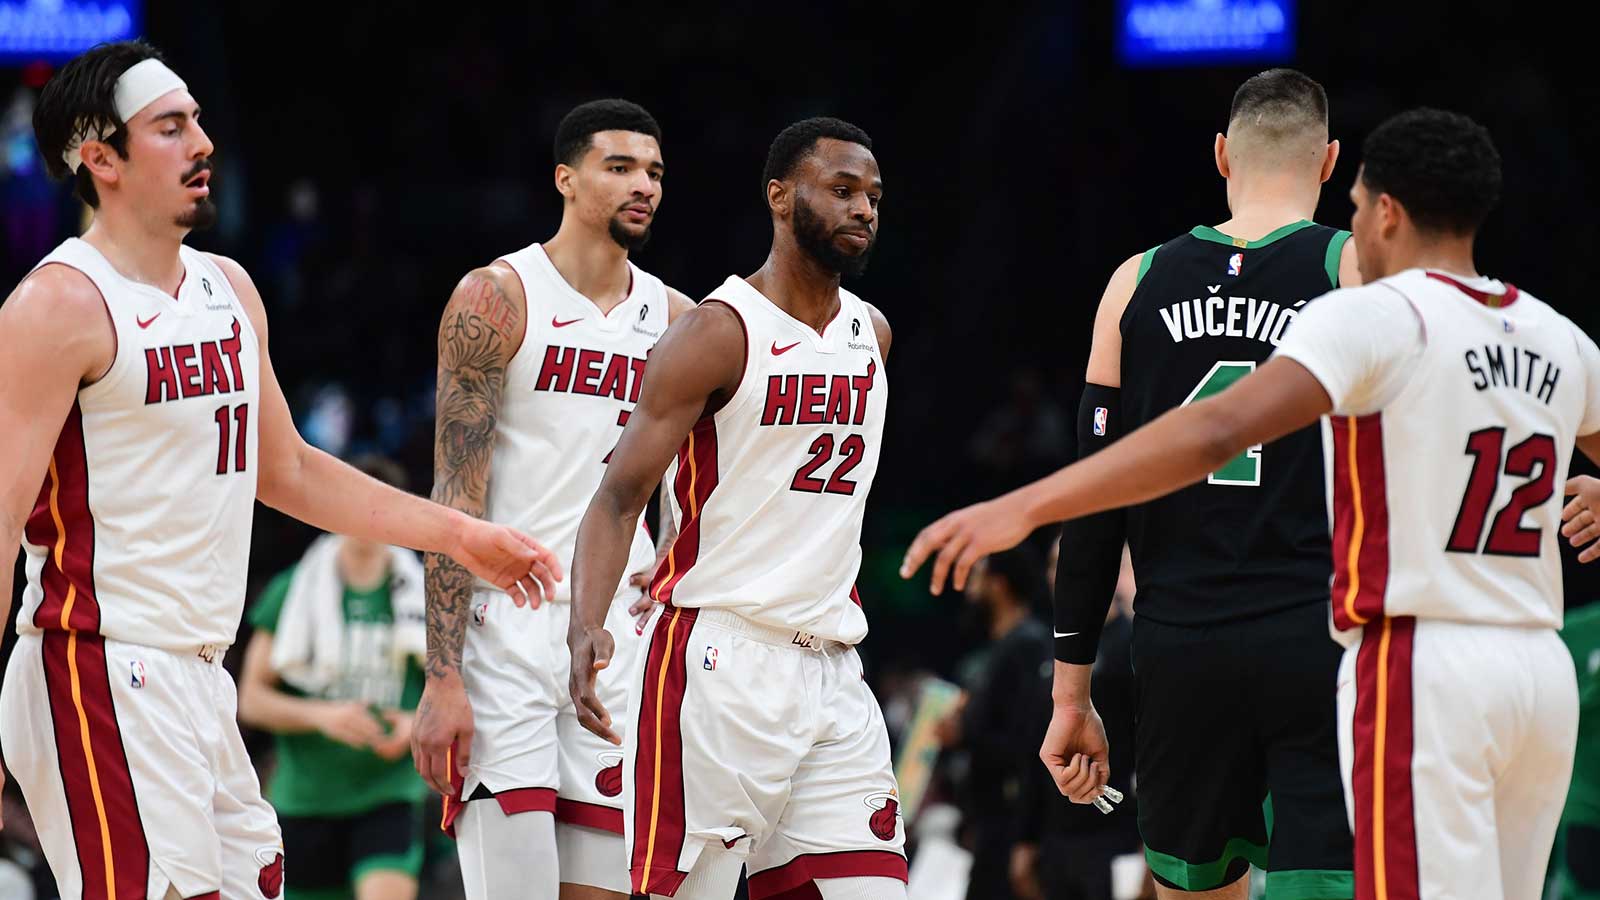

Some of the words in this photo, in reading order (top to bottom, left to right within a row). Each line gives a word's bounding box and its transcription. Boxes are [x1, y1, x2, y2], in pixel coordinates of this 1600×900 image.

[144, 314, 245, 406] HEAT
[759, 356, 877, 427] HEAT
[1464, 344, 1561, 405] SMITH
[214, 402, 249, 476] 11
[789, 432, 866, 496] 22
[1444, 425, 1558, 558] 12
